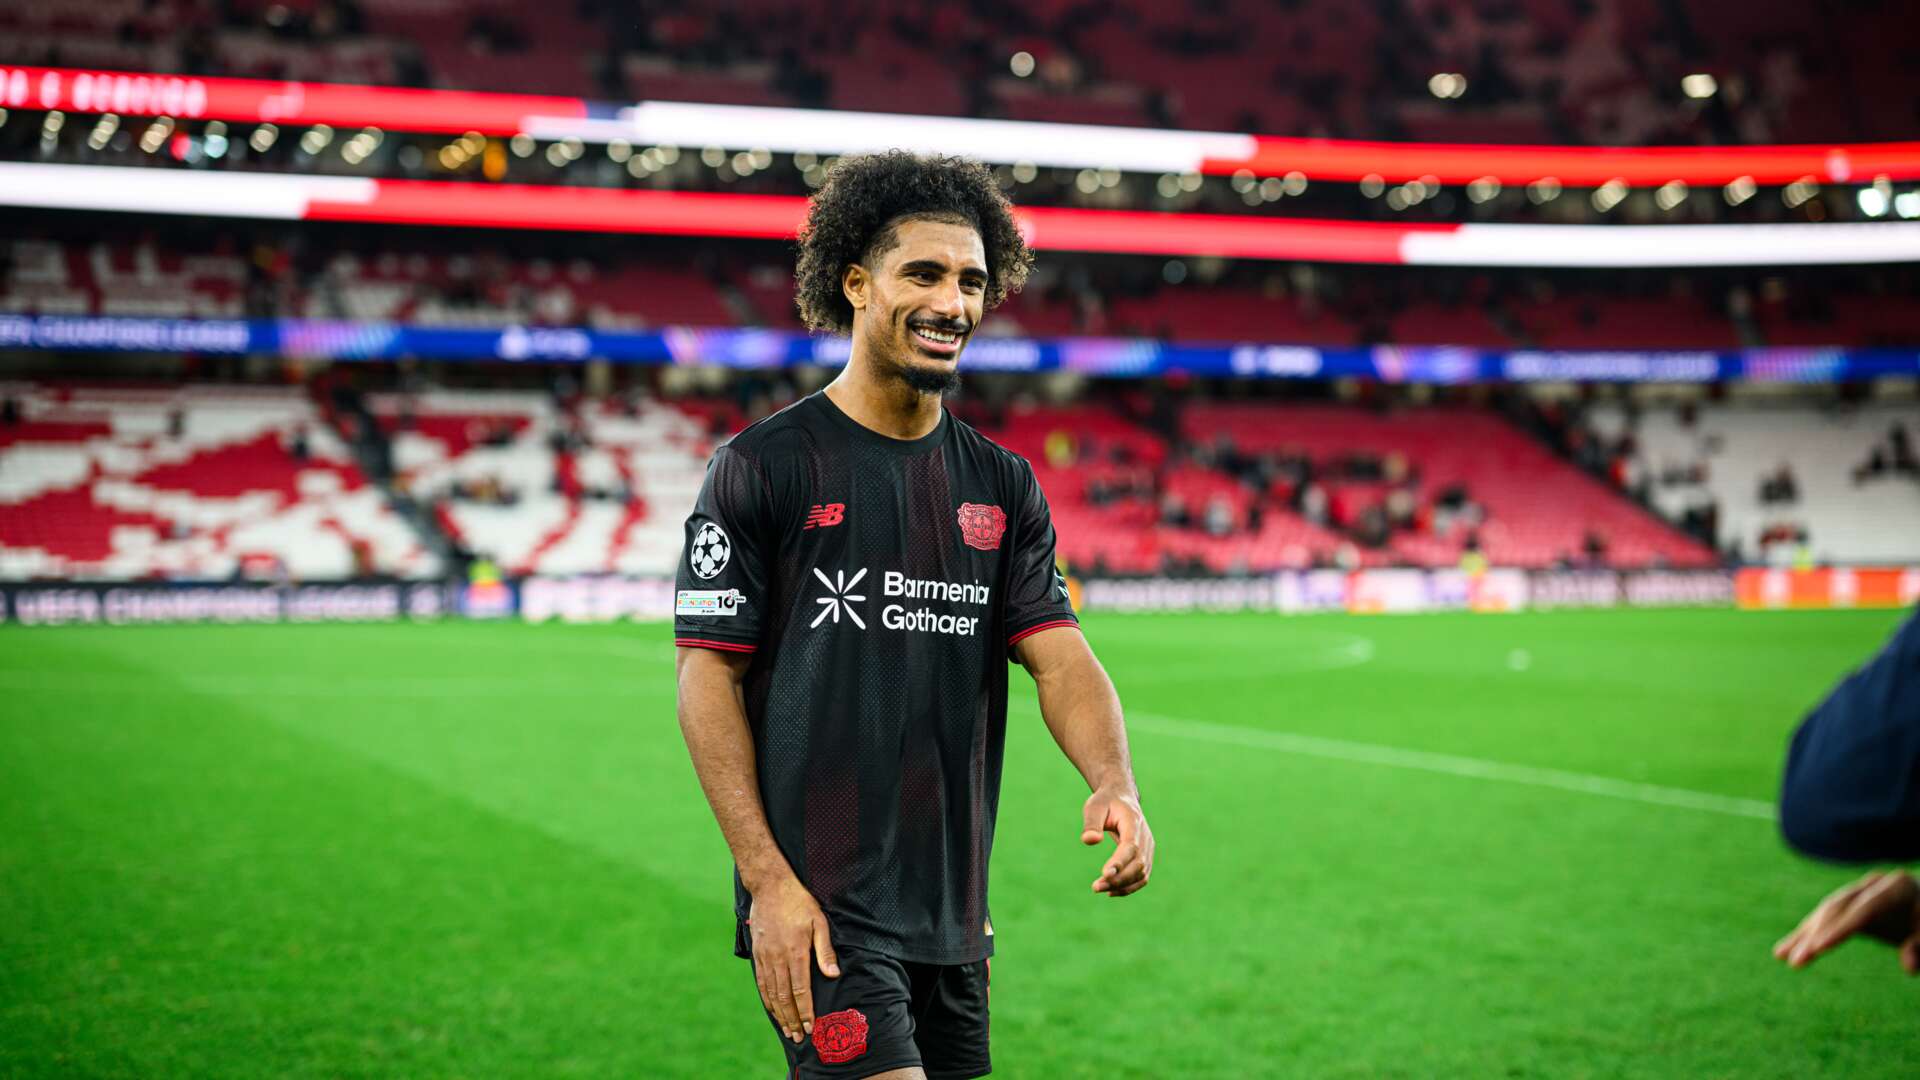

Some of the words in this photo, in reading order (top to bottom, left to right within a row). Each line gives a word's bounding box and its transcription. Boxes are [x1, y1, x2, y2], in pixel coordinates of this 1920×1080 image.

[717, 596, 735, 609] 10
[884, 571, 990, 604] Barmenia
[882, 604, 979, 636] Gothaer
